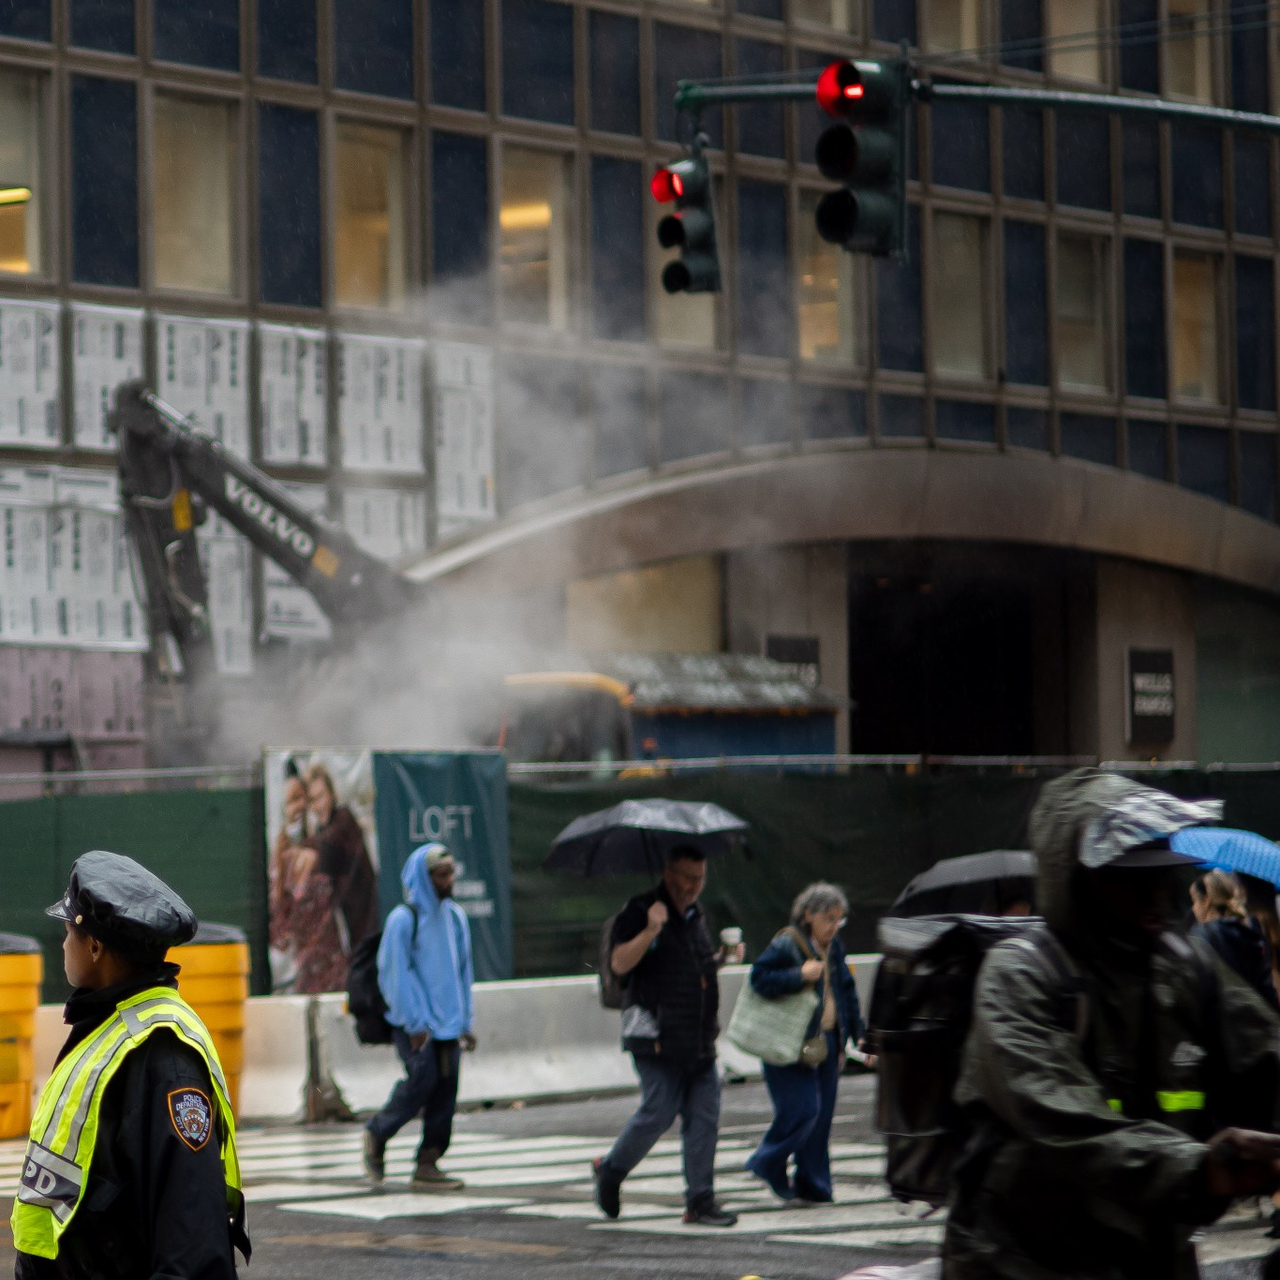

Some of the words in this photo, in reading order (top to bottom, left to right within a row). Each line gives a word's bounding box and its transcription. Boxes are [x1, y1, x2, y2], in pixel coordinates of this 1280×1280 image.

[224, 473, 314, 557] VOLVO
[409, 806, 473, 841] LOFT
[183, 1094, 202, 1102] POLICE
